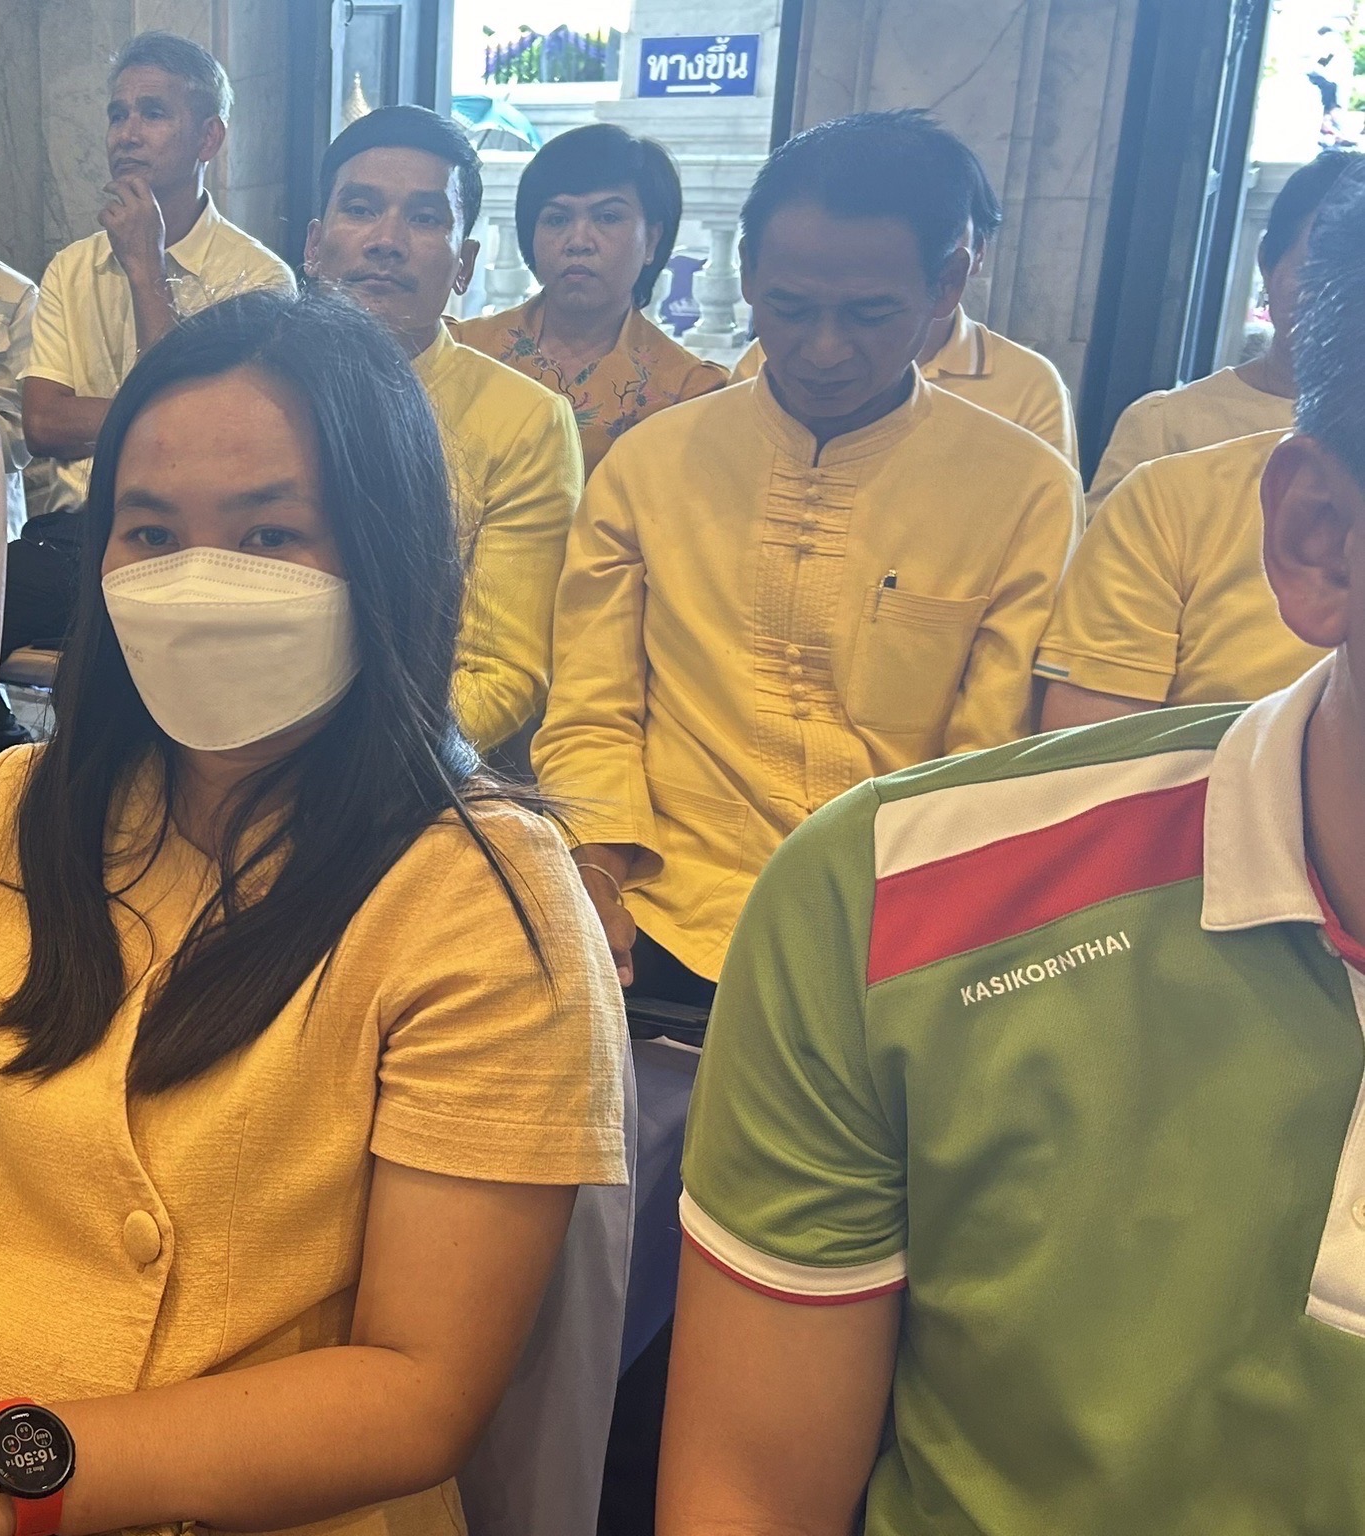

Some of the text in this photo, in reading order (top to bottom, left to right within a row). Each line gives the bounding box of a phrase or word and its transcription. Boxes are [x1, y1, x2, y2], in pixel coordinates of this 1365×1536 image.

[647, 37, 748, 81] ทางขึ้น
[960, 931, 1131, 1006] KASIKORNTHAI
[14, 1447, 57, 1468] 16:50
